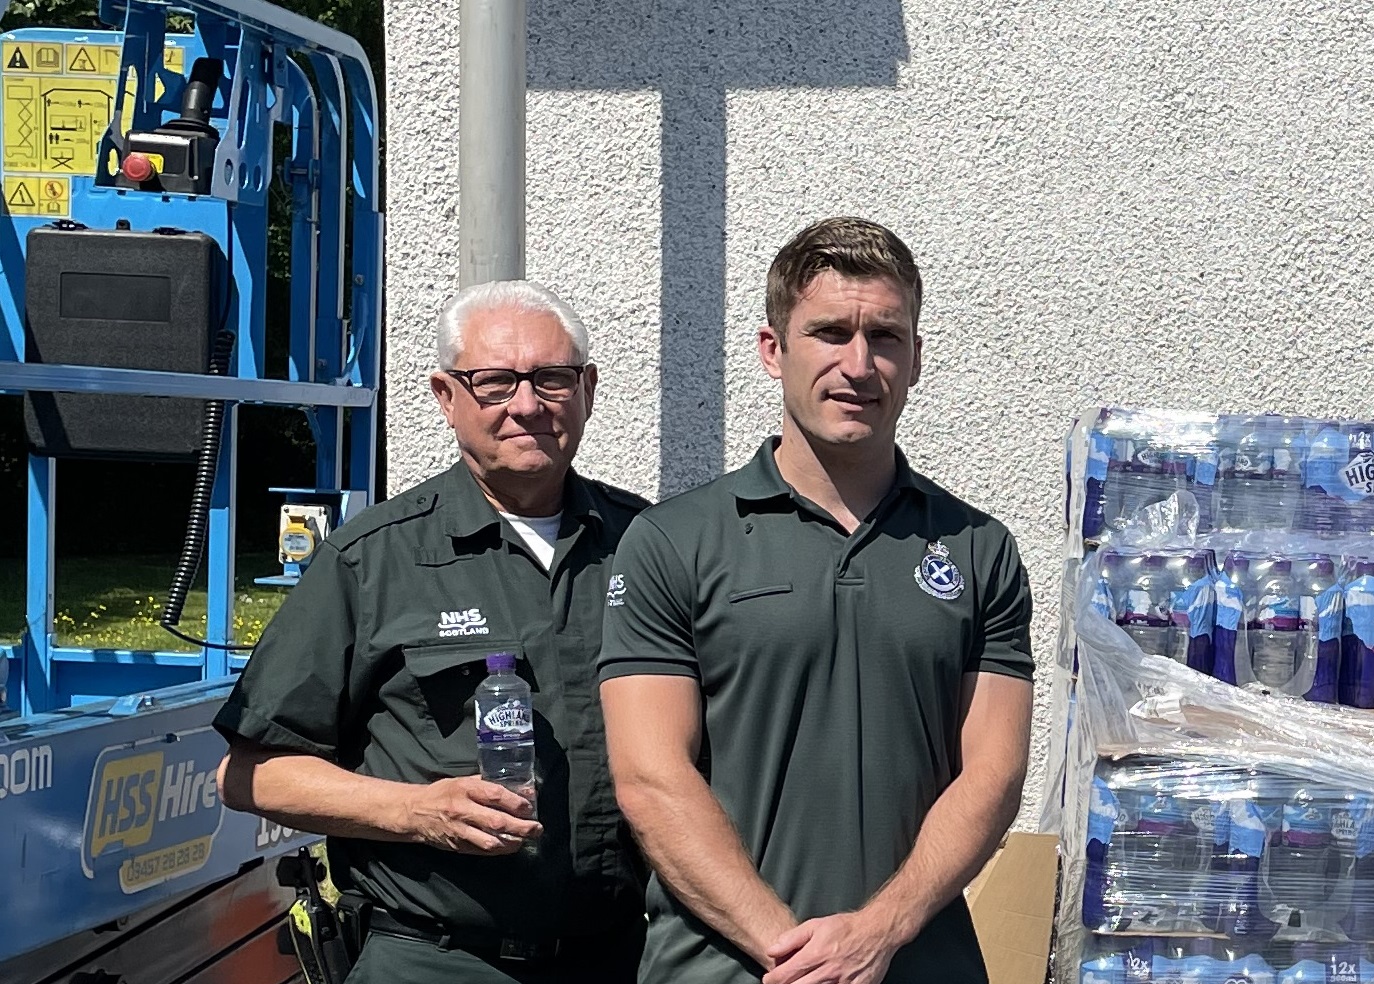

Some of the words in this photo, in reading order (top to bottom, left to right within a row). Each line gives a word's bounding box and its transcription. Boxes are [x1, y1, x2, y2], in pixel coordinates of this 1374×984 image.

[440, 608, 482, 625] NHS
[438, 627, 490, 637] SCOTLAND
[98, 769, 156, 839] HSS
[158, 760, 218, 821] Hire
[1330, 962, 1356, 975] 12x
